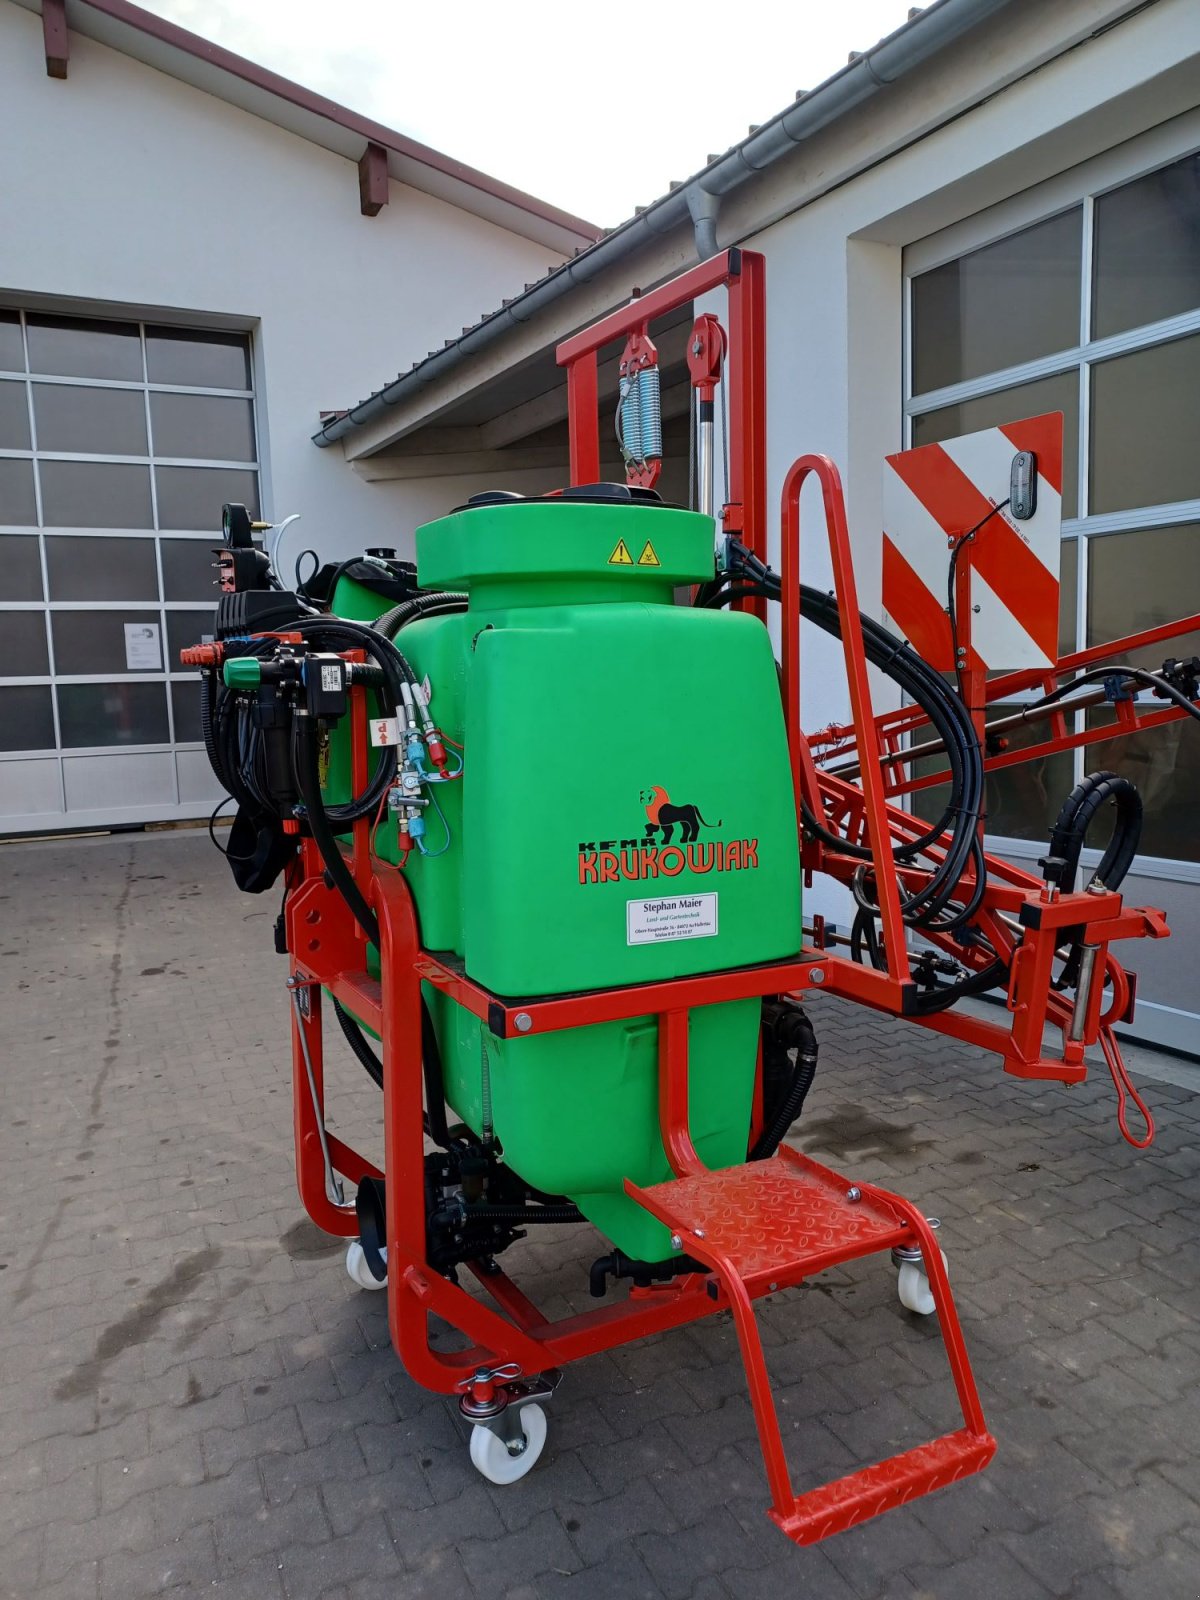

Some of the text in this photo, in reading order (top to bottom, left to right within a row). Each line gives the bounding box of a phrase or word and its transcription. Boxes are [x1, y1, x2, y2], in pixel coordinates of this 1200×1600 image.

[578, 836, 657, 852] KFMR
[578, 838, 758, 884] KRUKOWIAK
[643, 898, 703, 914] Stephan Maier
[659, 914, 669, 922] und
